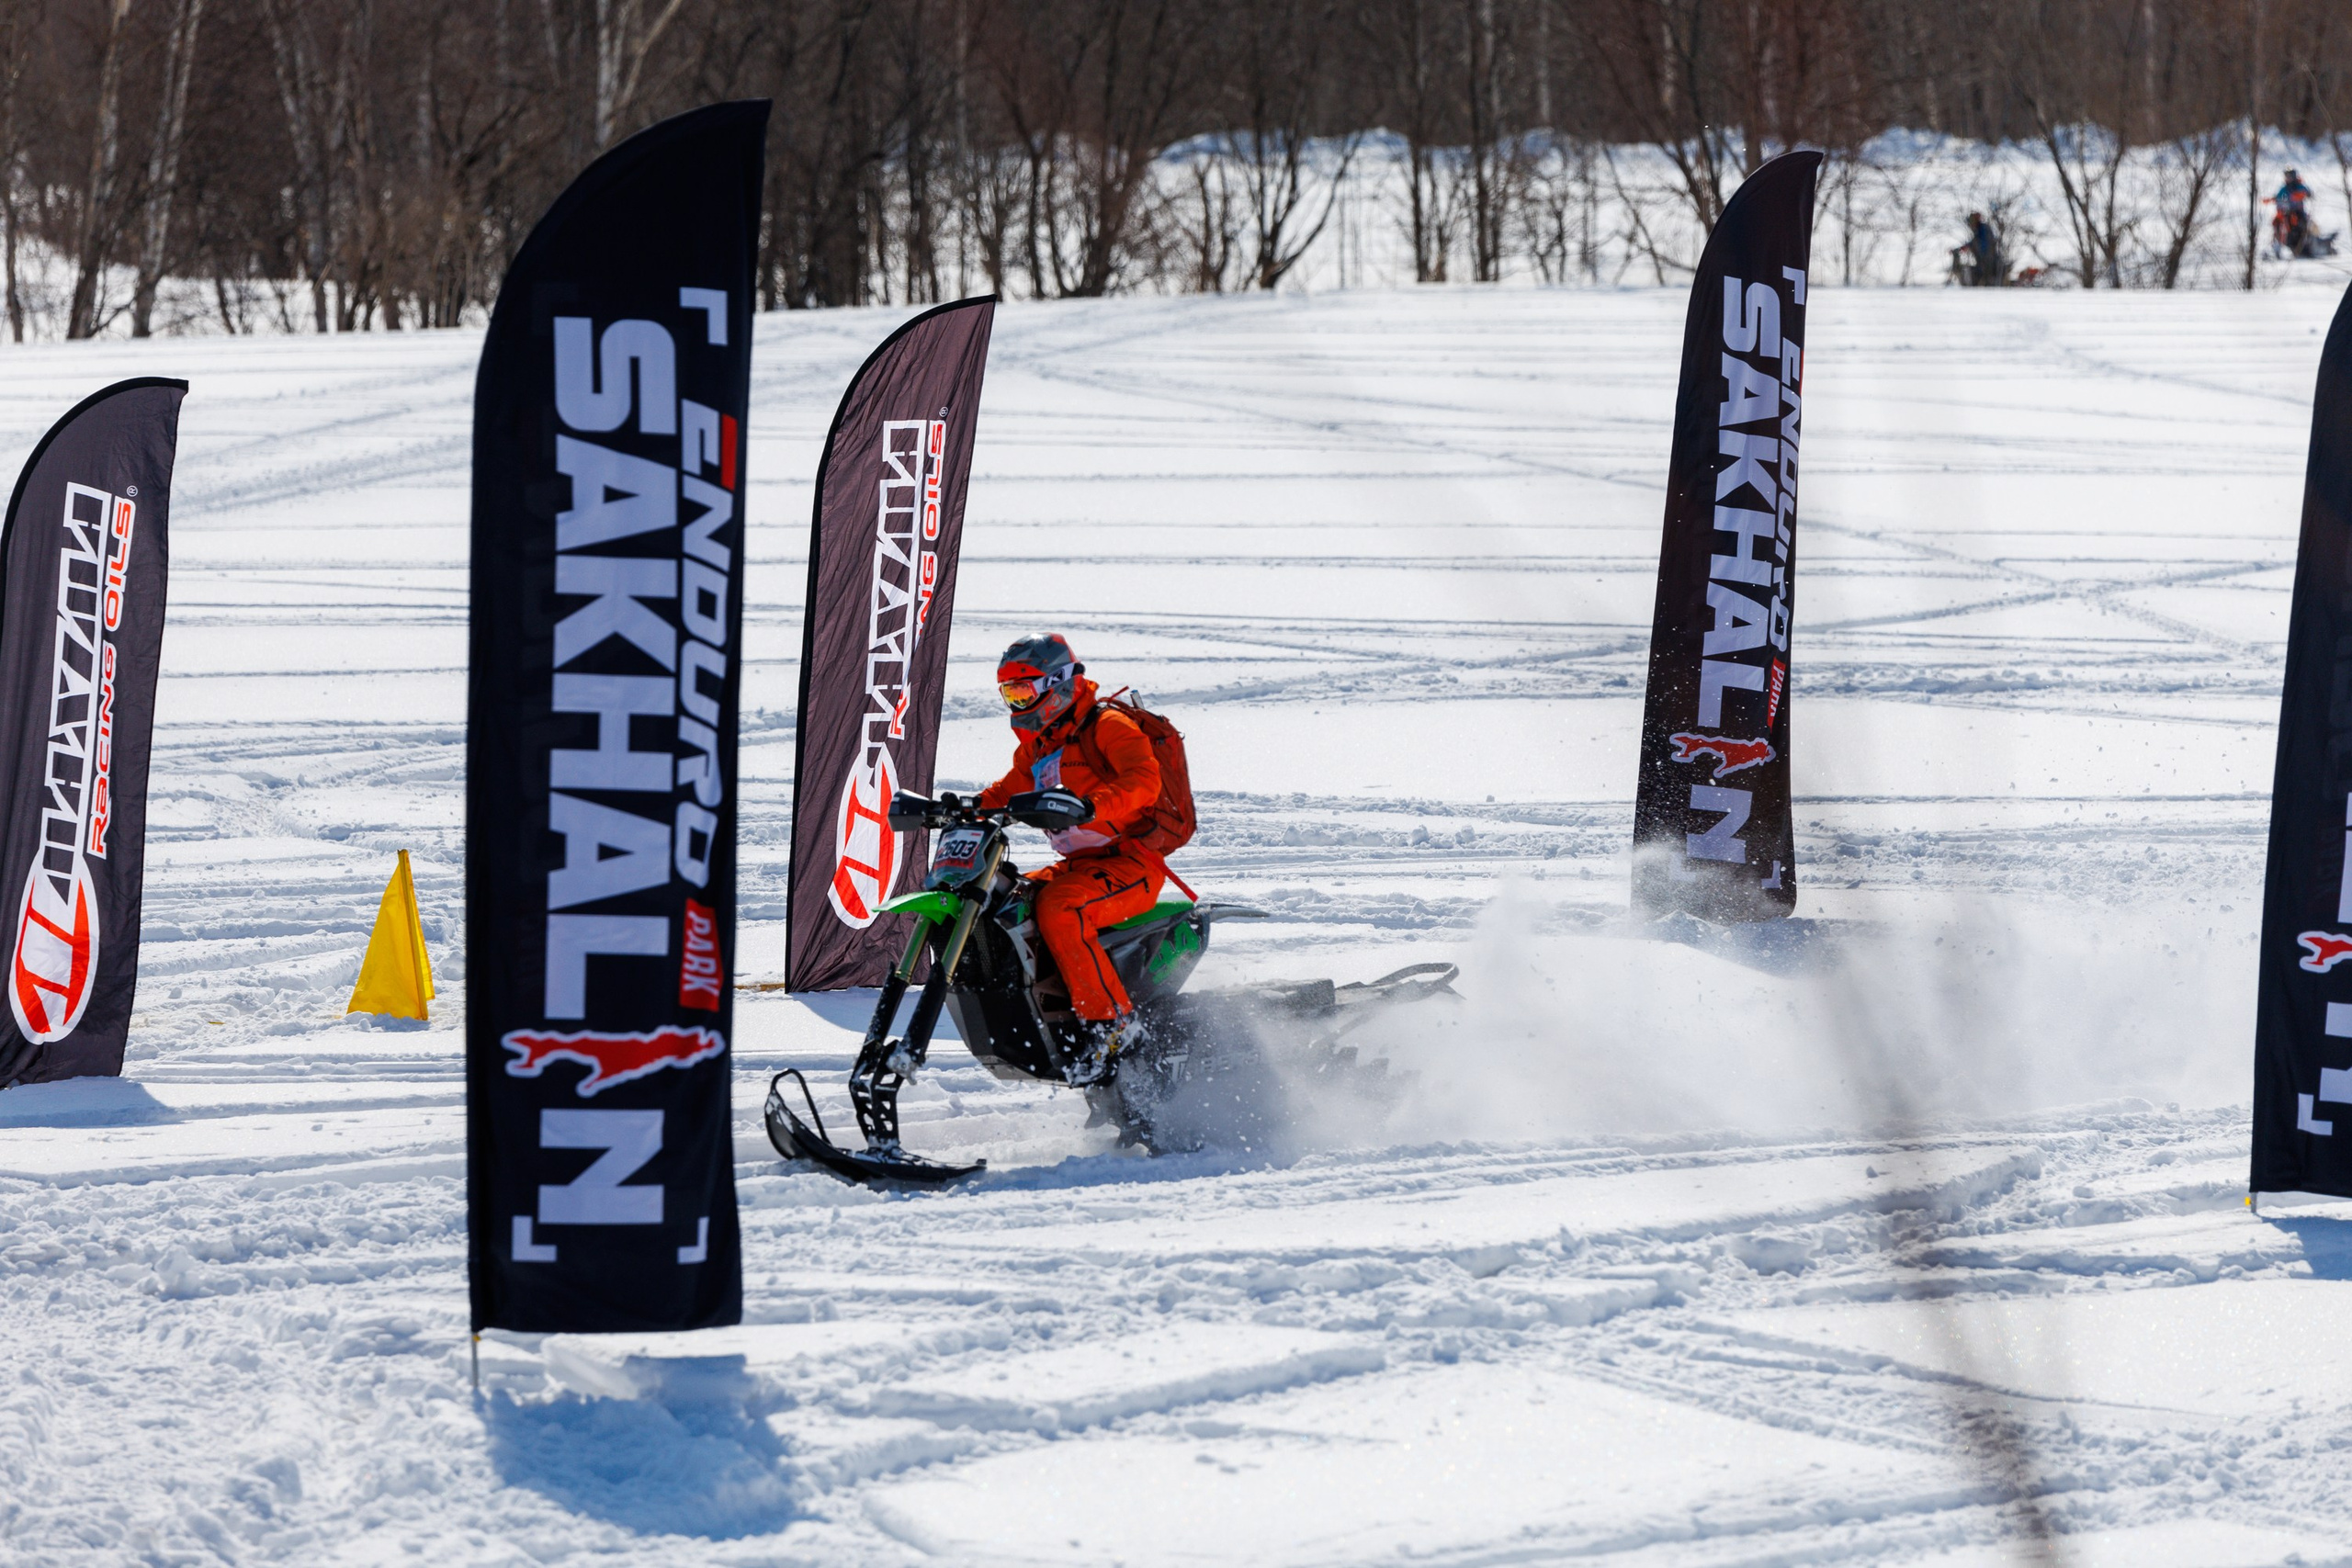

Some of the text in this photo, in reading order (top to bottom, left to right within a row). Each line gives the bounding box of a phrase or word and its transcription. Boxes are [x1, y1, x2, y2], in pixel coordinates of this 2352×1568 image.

[922, 419, 947, 540] OILS
[104, 494, 138, 633] OILS
[674, 398, 738, 999] ENDURO PARK
[937, 840, 978, 859] 2603
